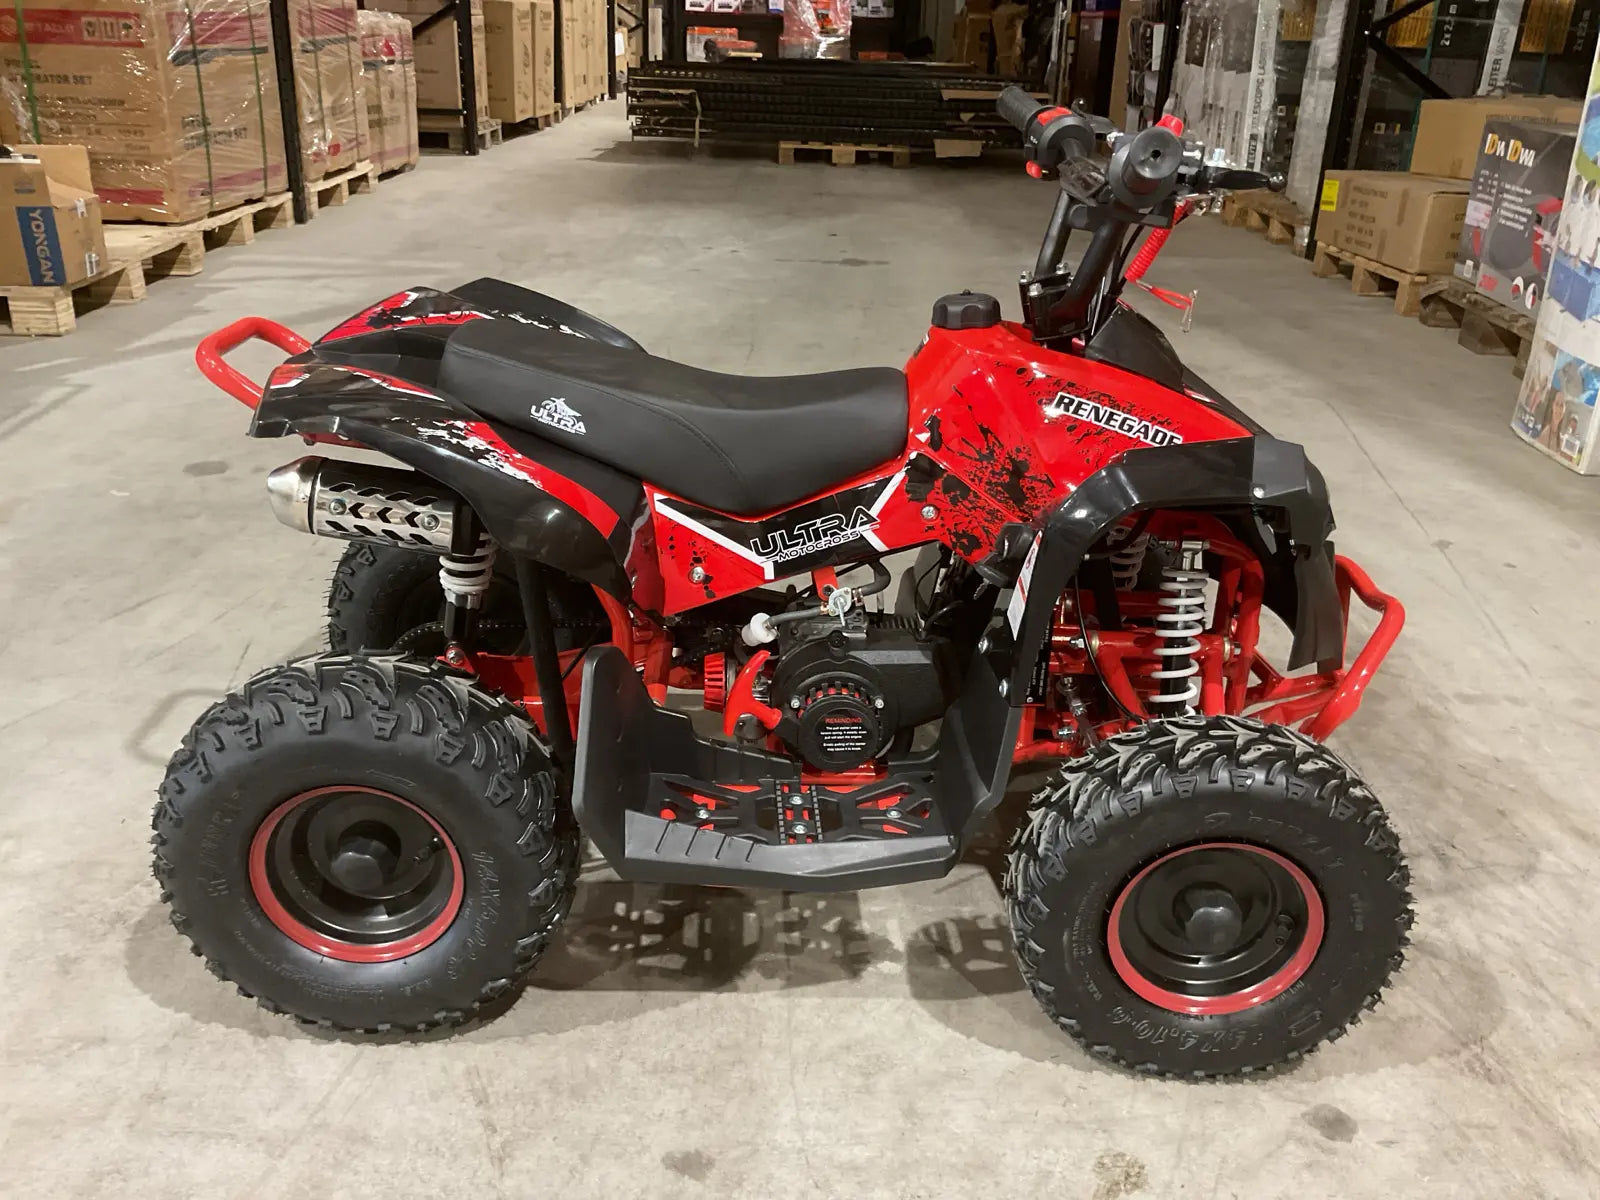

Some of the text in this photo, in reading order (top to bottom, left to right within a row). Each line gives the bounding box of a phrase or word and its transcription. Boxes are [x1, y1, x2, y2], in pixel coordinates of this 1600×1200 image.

[28, 208, 57, 284] YONGAN
[529, 405, 586, 434] ULTRA
[1053, 392, 1183, 446] RENEGADE
[750, 505, 880, 558] ULTRA
[777, 530, 860, 563] MOTOCROSS
